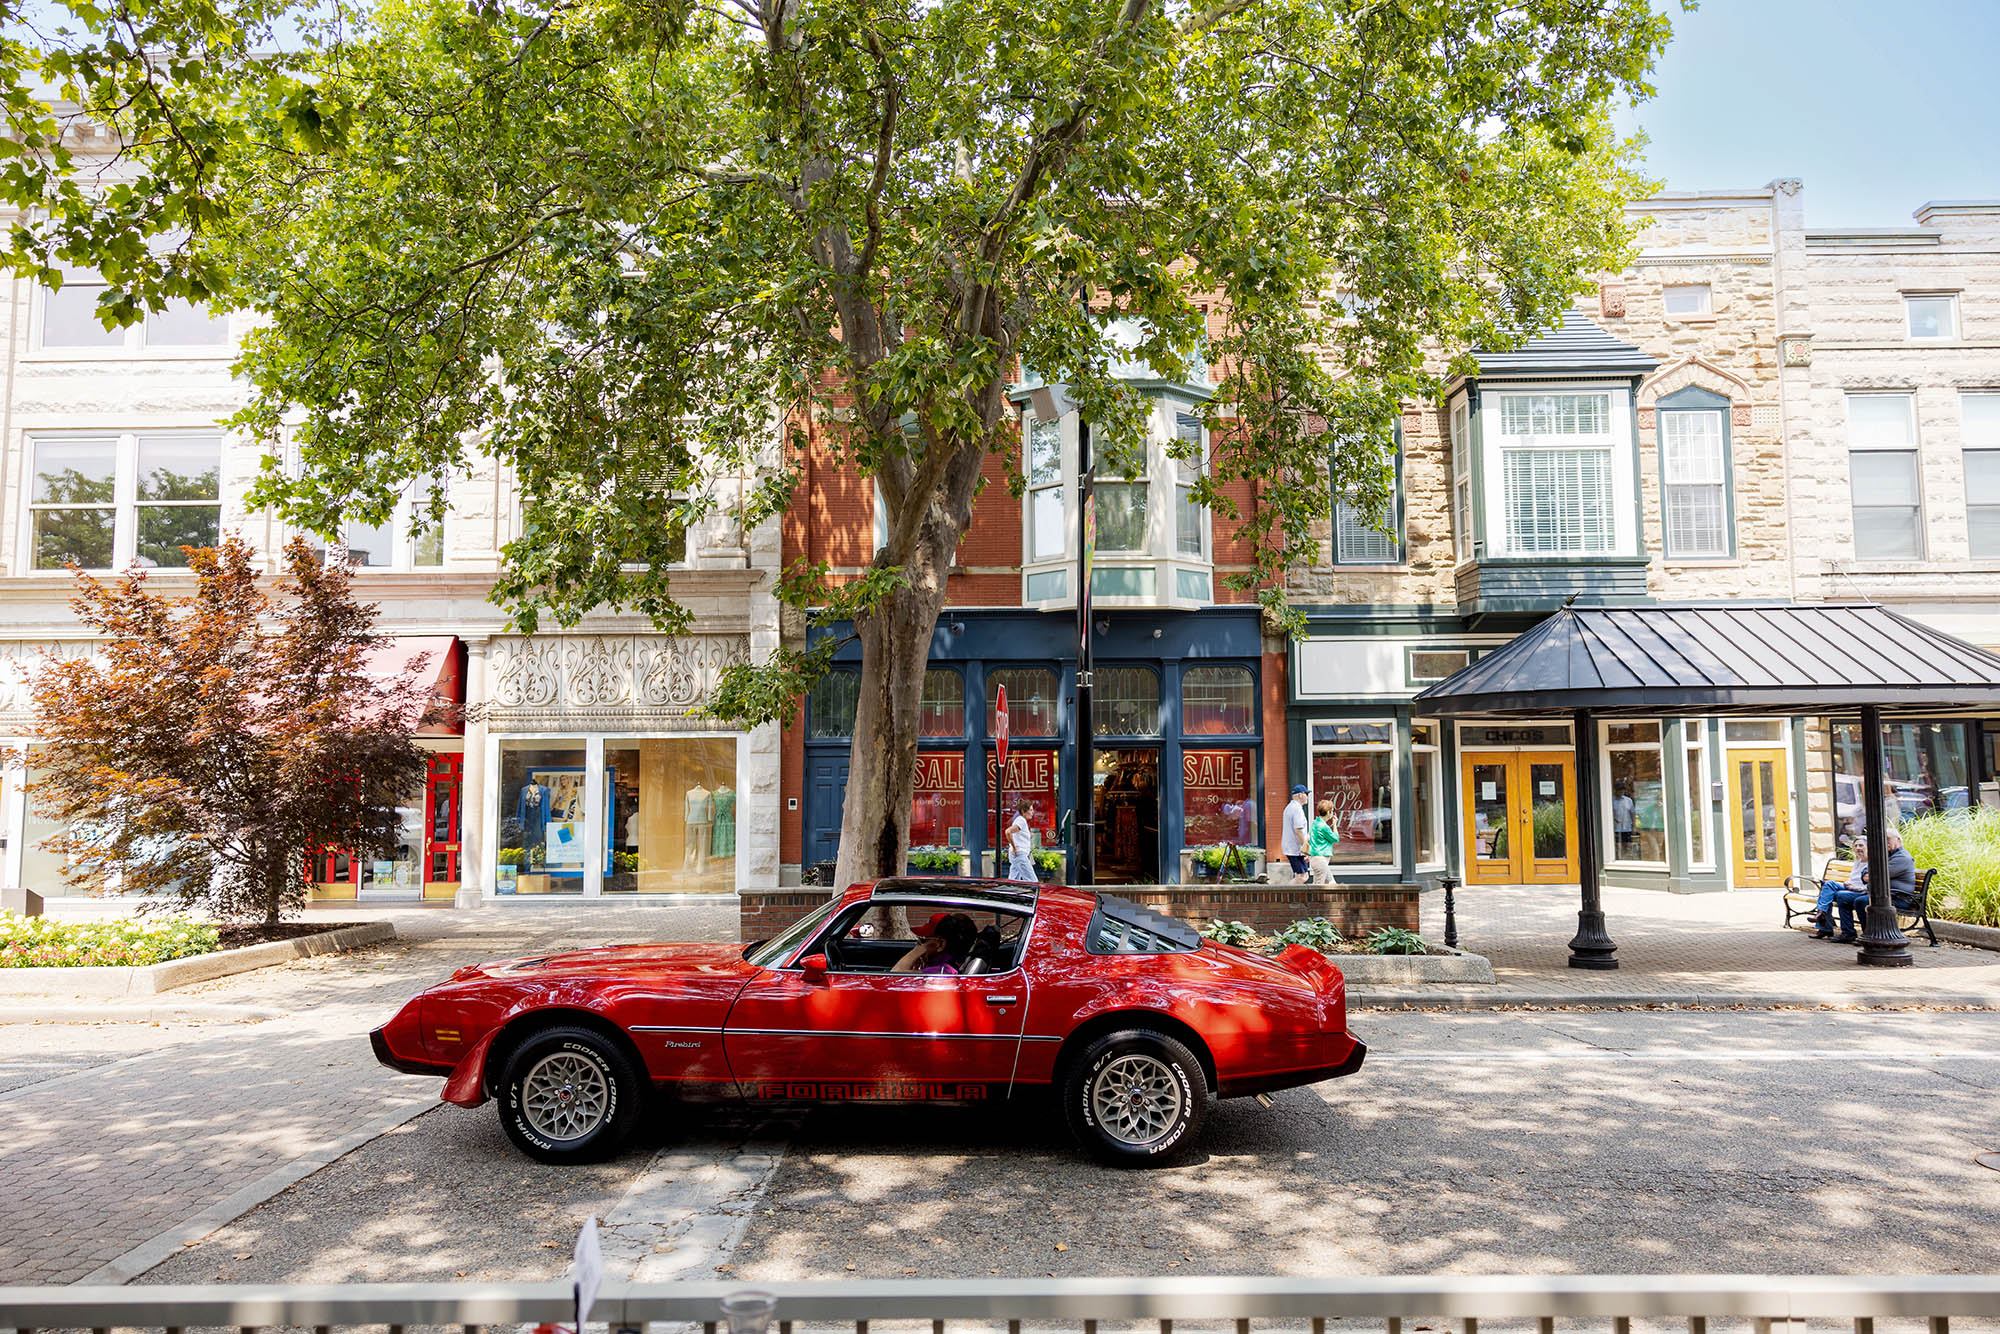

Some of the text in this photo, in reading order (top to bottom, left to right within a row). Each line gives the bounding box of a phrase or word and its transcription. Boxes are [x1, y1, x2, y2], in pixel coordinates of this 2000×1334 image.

[996, 710, 1008, 740] STOP
[987, 758, 1048, 789] SALE
[1183, 755, 1243, 785] SALE
[664, 1040, 701, 1049] Firebird
[563, 1042, 617, 1123] COOPER COBRA
[757, 1082, 988, 1100] FORMULA
[1082, 1051, 1113, 1126] RADIAL G/T
[1149, 1062, 1192, 1155] COOPER COBRA
[515, 1115, 552, 1150] RADIAL
